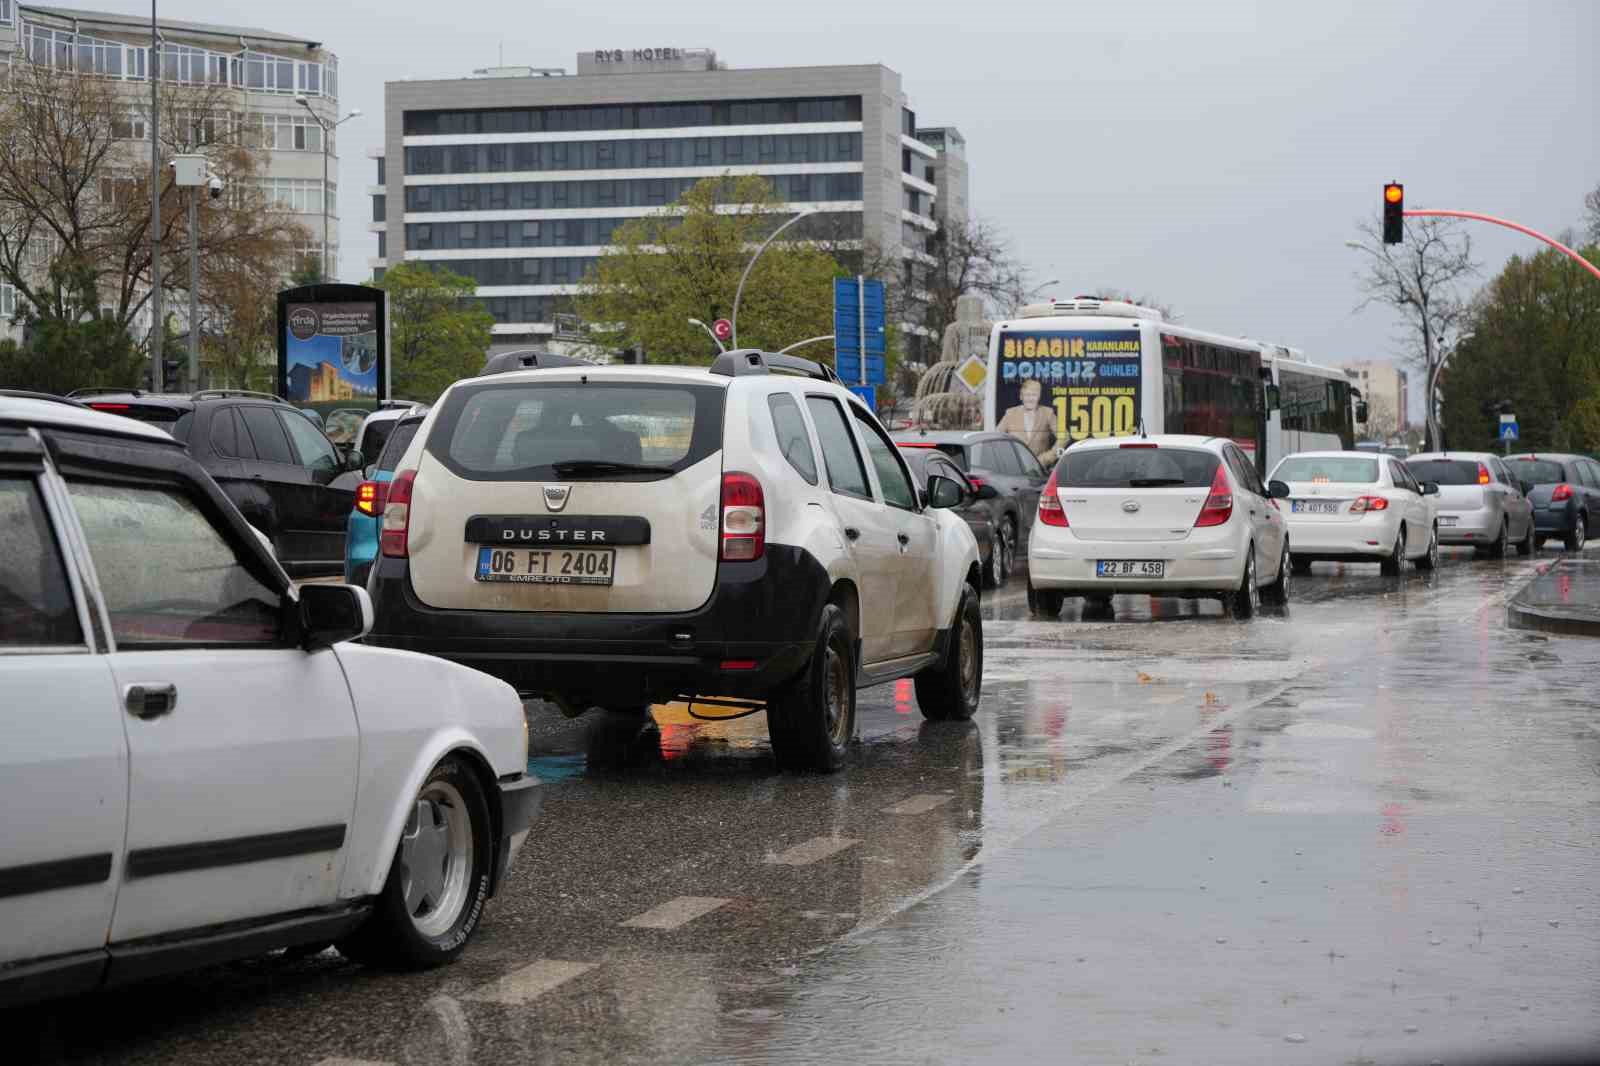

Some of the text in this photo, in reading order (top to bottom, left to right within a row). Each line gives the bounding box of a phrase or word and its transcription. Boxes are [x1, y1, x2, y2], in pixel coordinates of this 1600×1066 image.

[594, 47, 681, 63] RYS HOTEL
[1002, 361, 1138, 379] DONSUZ GÜNLER
[1052, 396, 1134, 440] 1500
[503, 529, 606, 541] DUSTER
[492, 550, 609, 575] 06 FT 2404
[1104, 562, 1162, 574] 22 BF 458
